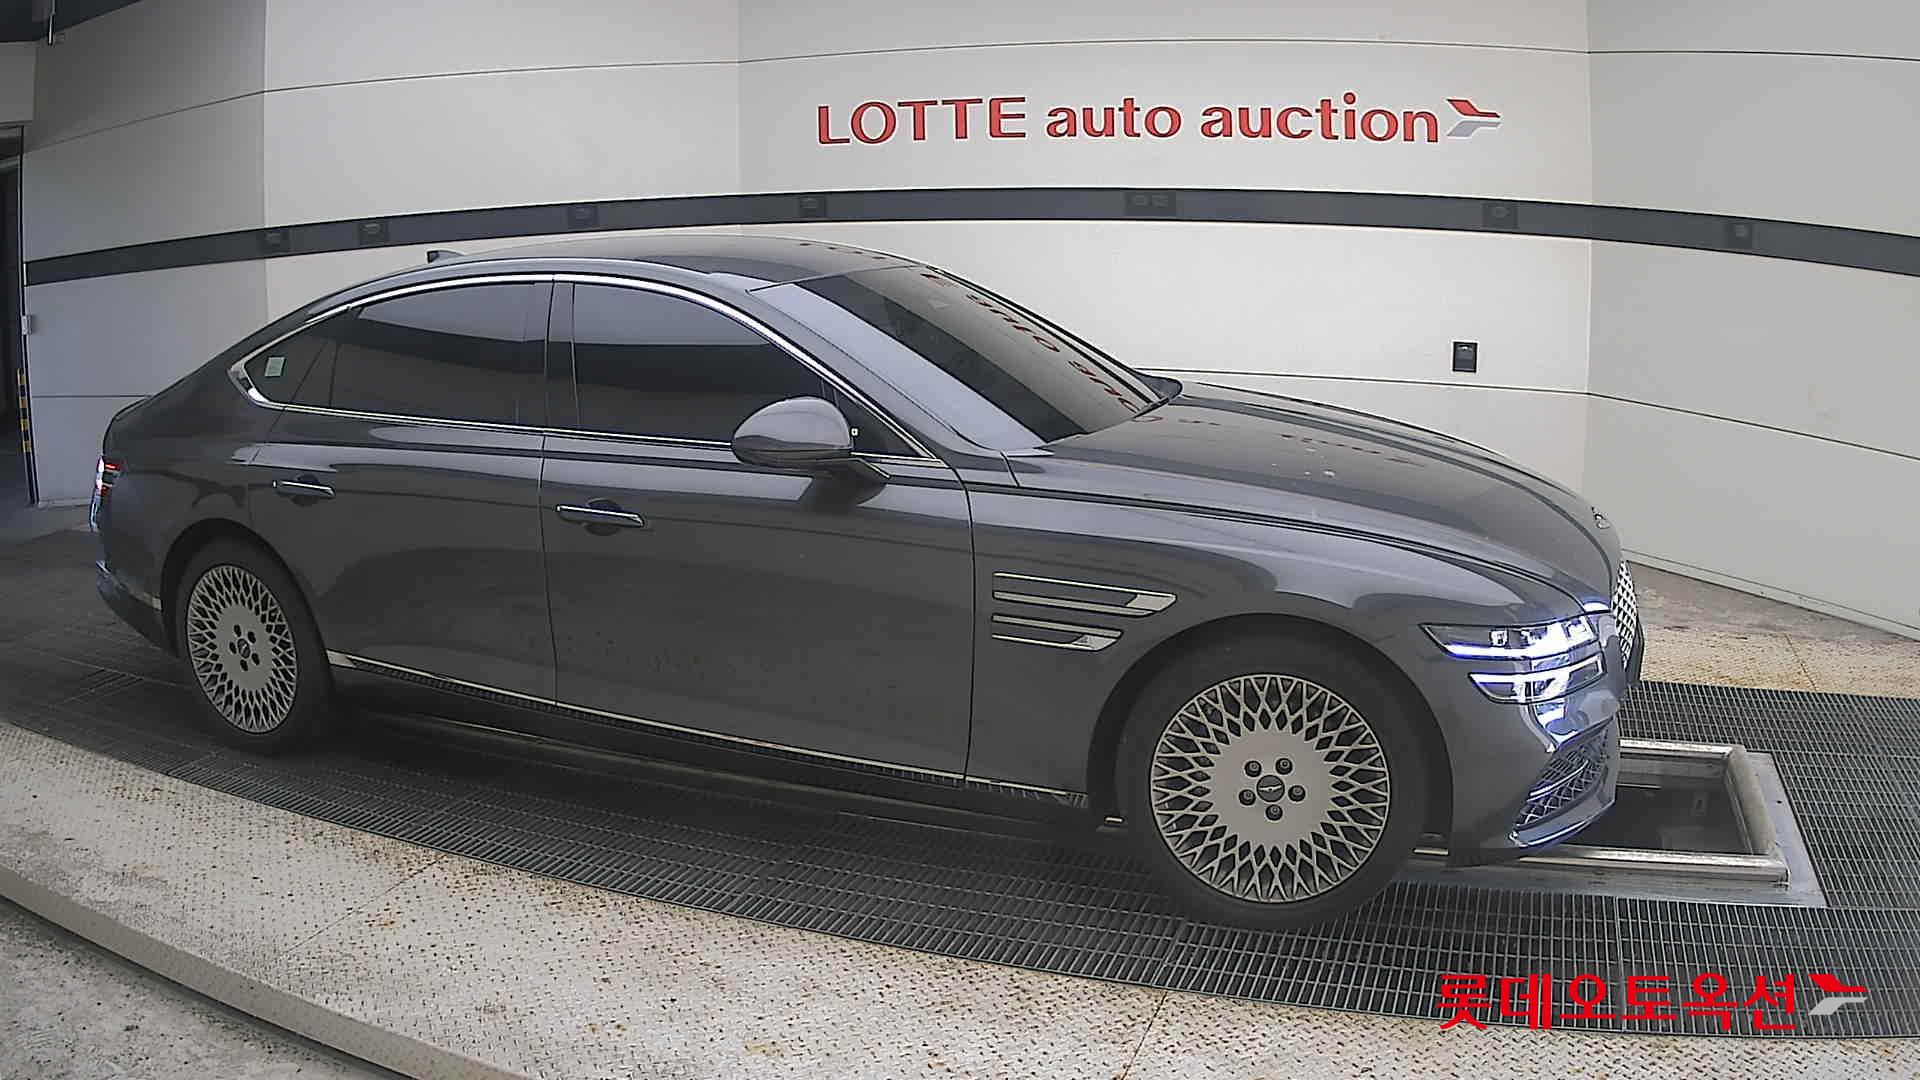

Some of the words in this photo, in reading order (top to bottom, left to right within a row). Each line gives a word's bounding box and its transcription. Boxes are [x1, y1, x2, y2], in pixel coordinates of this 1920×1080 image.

[818, 97, 1026, 145] LOTTE
[1046, 97, 1182, 138] auto
[1201, 92, 1439, 144] auction
